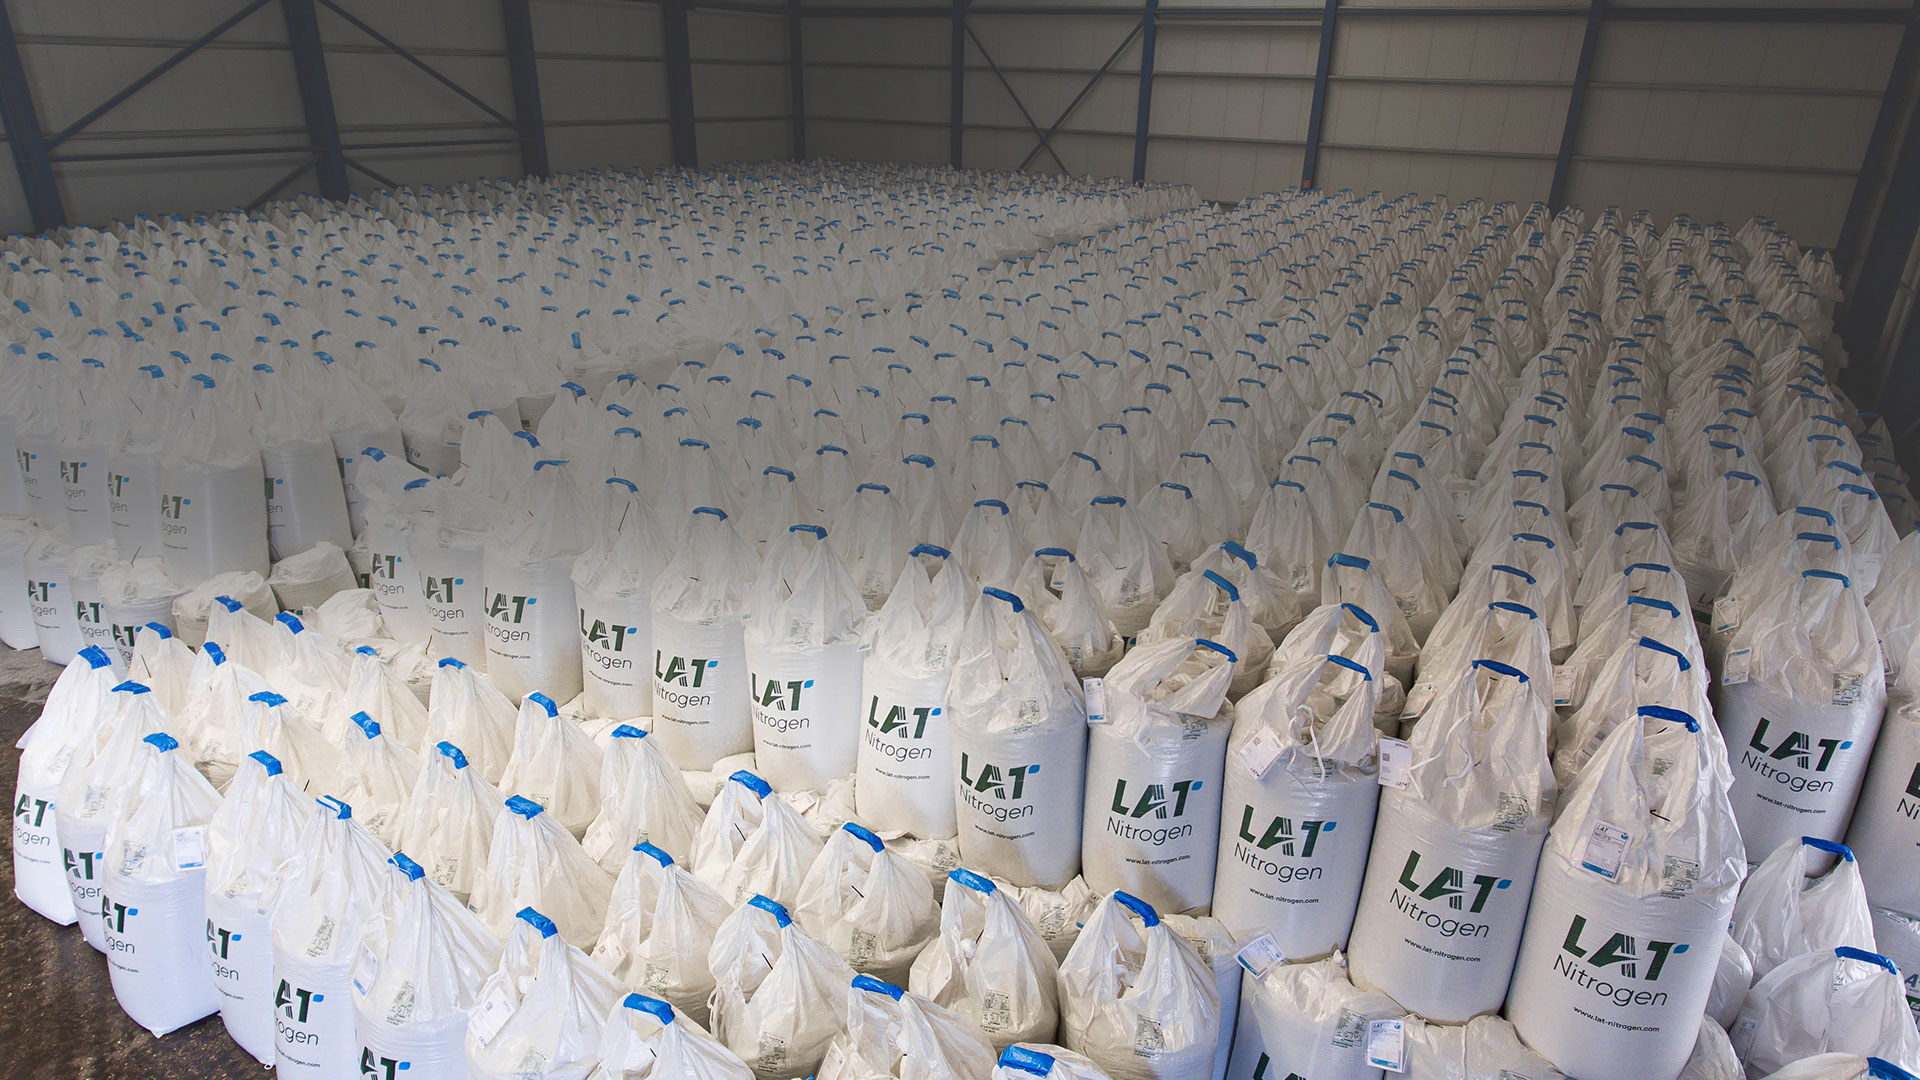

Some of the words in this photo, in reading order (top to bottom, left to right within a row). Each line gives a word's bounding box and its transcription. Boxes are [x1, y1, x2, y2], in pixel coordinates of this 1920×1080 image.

[161, 494, 191, 519] AT
[371, 553, 402, 579] AT
[28, 580, 57, 602] AT
[77, 600, 105, 624] AT
[580, 608, 637, 651] LAT
[112, 623, 142, 647] AT
[655, 649, 719, 688] LAT
[751, 672, 814, 711] LAT
[752, 703, 810, 733] Nitrogen
[868, 695, 942, 739] LAT
[864, 728, 932, 762] Nitrogen
[1749, 717, 1854, 771] LAT
[961, 751, 1041, 800] LAT
[1741, 750, 1834, 793] Nitrogen
[15, 793, 55, 827] AT
[959, 783, 1034, 822] Nitrogen
[1111, 778, 1203, 820] LAT
[1755, 792, 1827, 814] www.lat-nitrogen.com
[1106, 815, 1193, 846] Nitrogen
[1239, 803, 1337, 858] LAT
[63, 847, 103, 880] AT
[1125, 854, 1191, 866] www.lat-nitrogen.com
[1233, 842, 1323, 884] Nitrogen
[1248, 886, 1320, 905] www.lat-nitrogen.com
[1398, 850, 1513, 914] LAT
[102, 895, 139, 934] AT
[1389, 888, 1490, 938] Nitrogen
[1403, 937, 1482, 963] www.lat-nitrogen.com
[1562, 914, 1690, 981] LAT
[1553, 954, 1668, 1007] Nitrogen
[275, 978, 325, 1023] AT
[1573, 1005, 1660, 1033] www.lat-nitrogen.com
